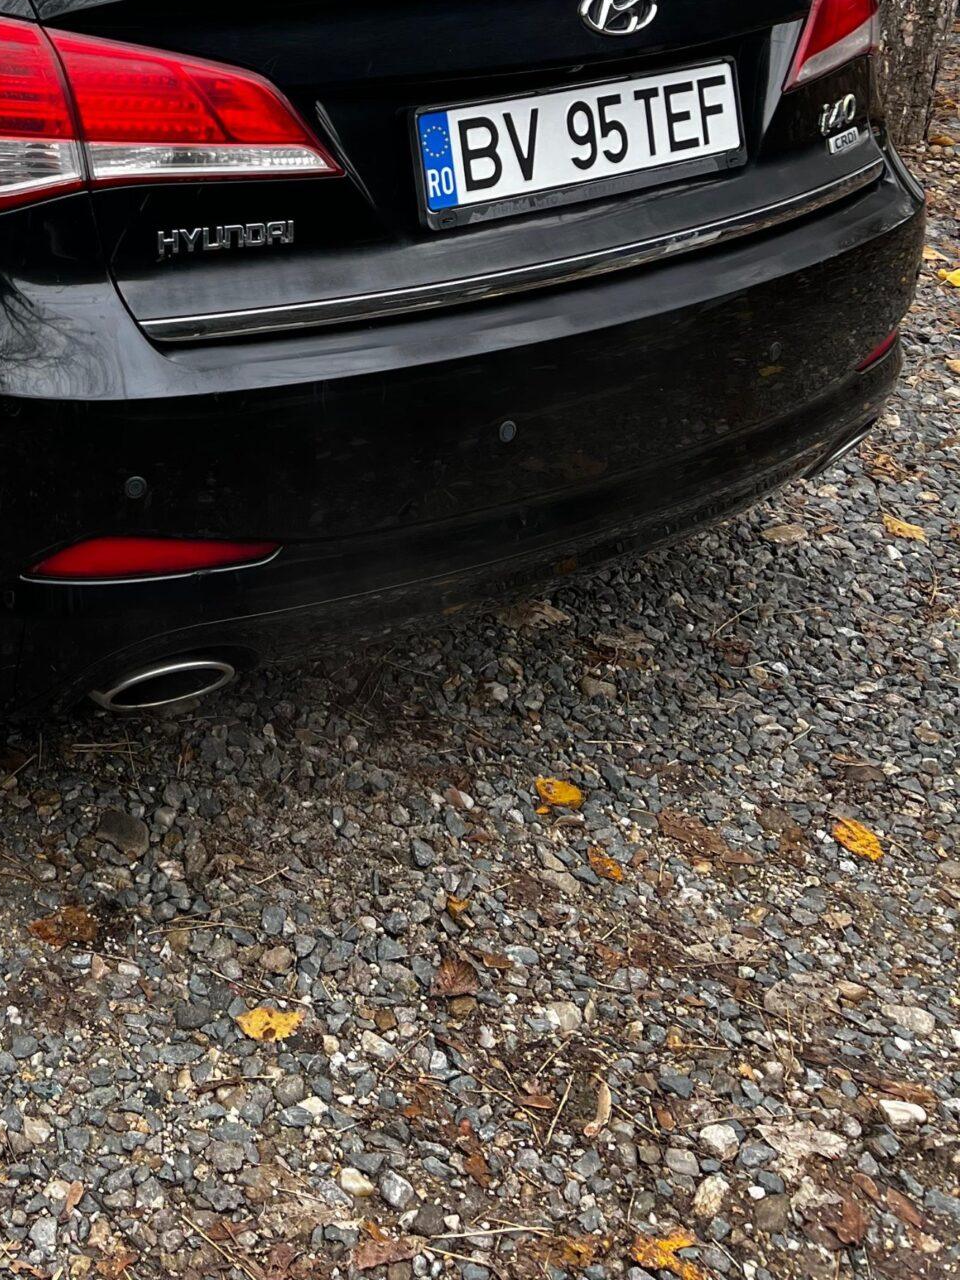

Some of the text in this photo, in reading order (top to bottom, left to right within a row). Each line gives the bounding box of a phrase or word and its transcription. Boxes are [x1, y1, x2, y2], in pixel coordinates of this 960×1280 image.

[819, 93, 856, 136] i40
[457, 108, 539, 192] BV
[426, 166, 455, 198] RO
[157, 220, 295, 255] HYUNDAI
